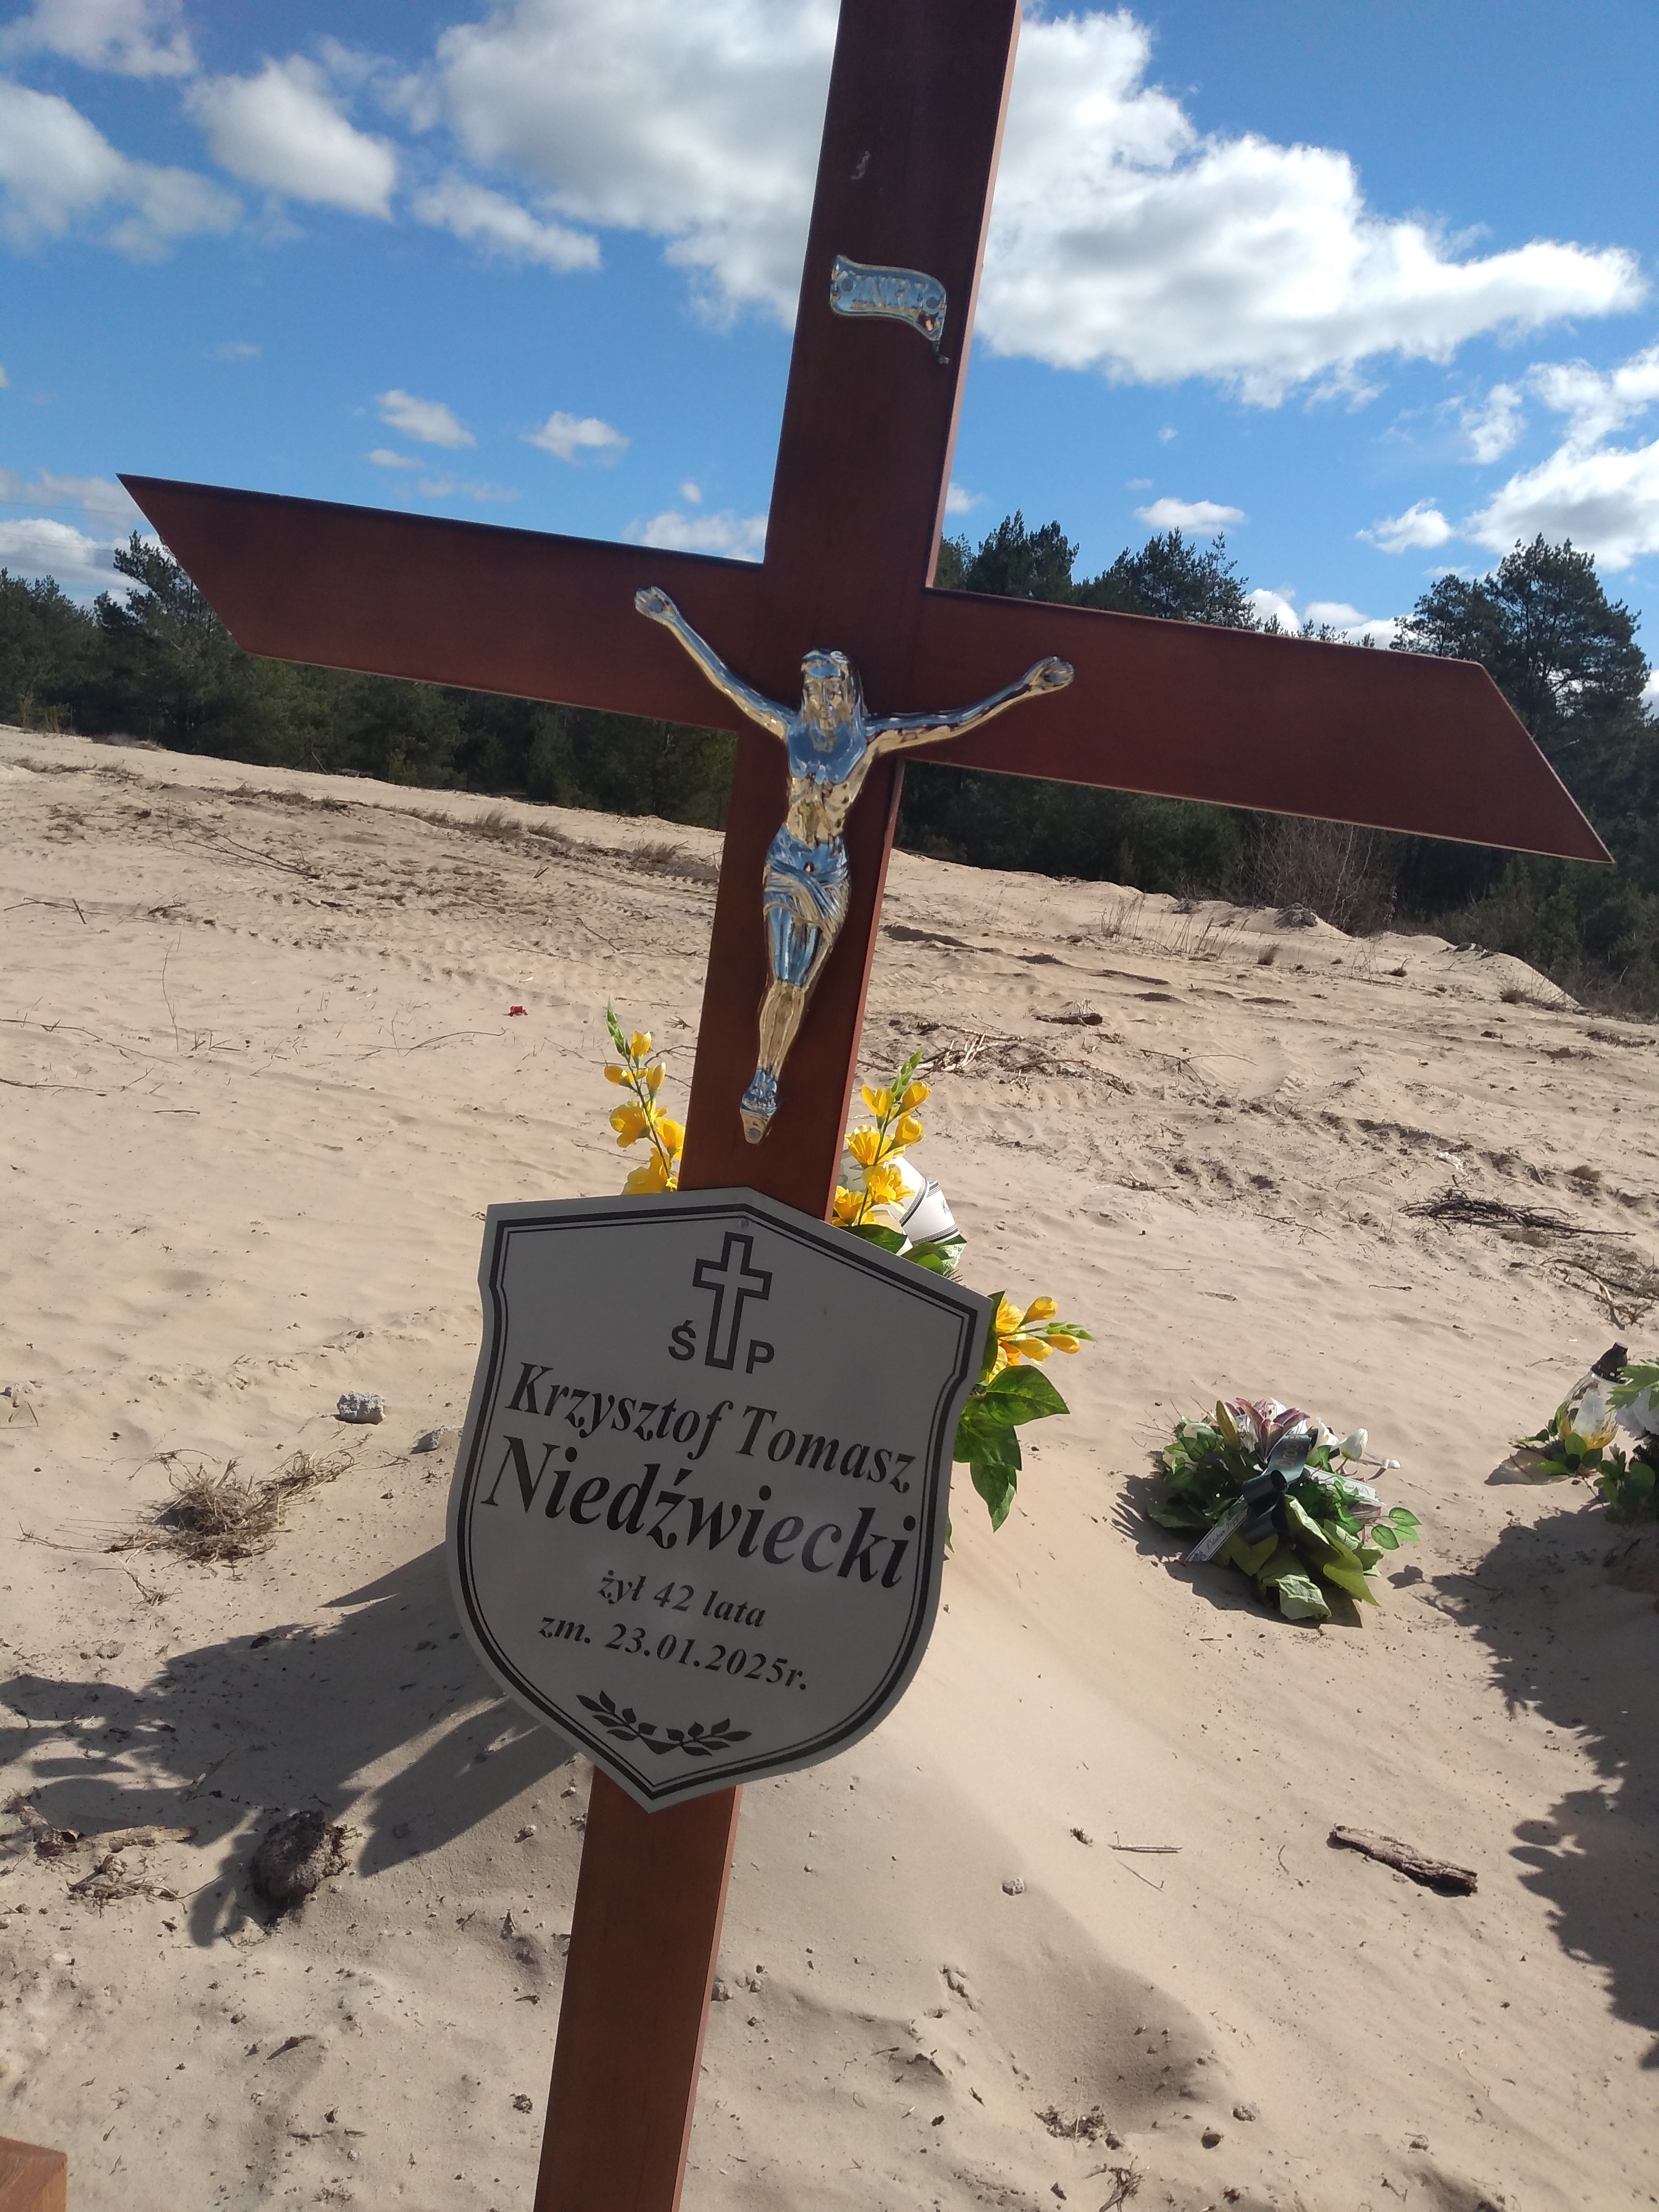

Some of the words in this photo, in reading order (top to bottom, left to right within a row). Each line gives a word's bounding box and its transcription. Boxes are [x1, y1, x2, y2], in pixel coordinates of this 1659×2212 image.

[668, 1319, 697, 1361] Ś
[745, 1339, 775, 1375] P
[504, 1362, 734, 1461] Krzysztof
[735, 1405, 916, 1493] Tomasz
[480, 1435, 916, 1588] Niedźwiecki
[597, 1569, 647, 1605] żył
[653, 1581, 694, 1612] 42
[702, 1590, 766, 1628] lata
[538, 1616, 591, 1644] zm.
[604, 1623, 807, 1691] 23.01.2025r.
